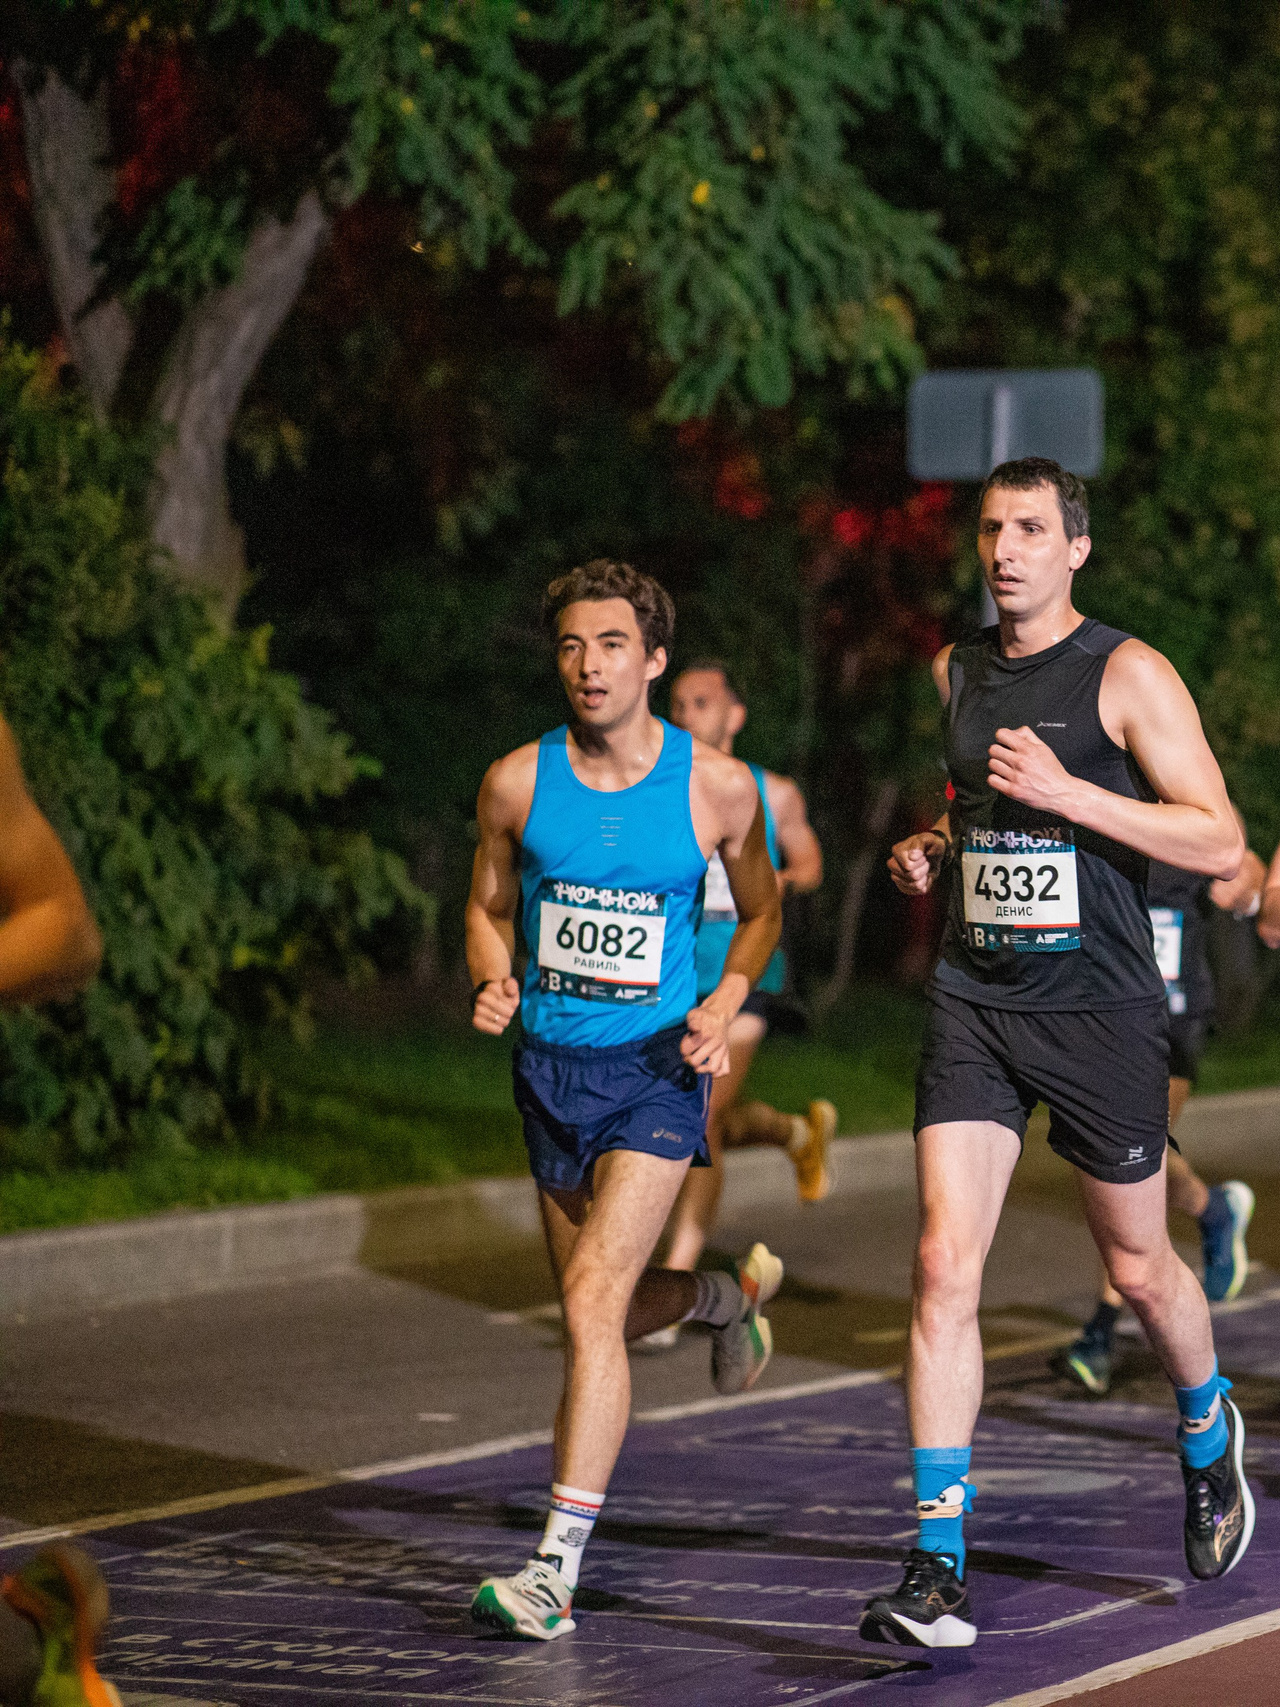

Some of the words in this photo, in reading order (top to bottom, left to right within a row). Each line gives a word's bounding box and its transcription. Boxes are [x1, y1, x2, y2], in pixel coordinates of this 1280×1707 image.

[974, 865, 1061, 902] 4332
[995, 906, 1034, 918] ДЕНИС
[555, 917, 648, 960] 6082
[573, 956, 622, 972] РАВИЛЬ
